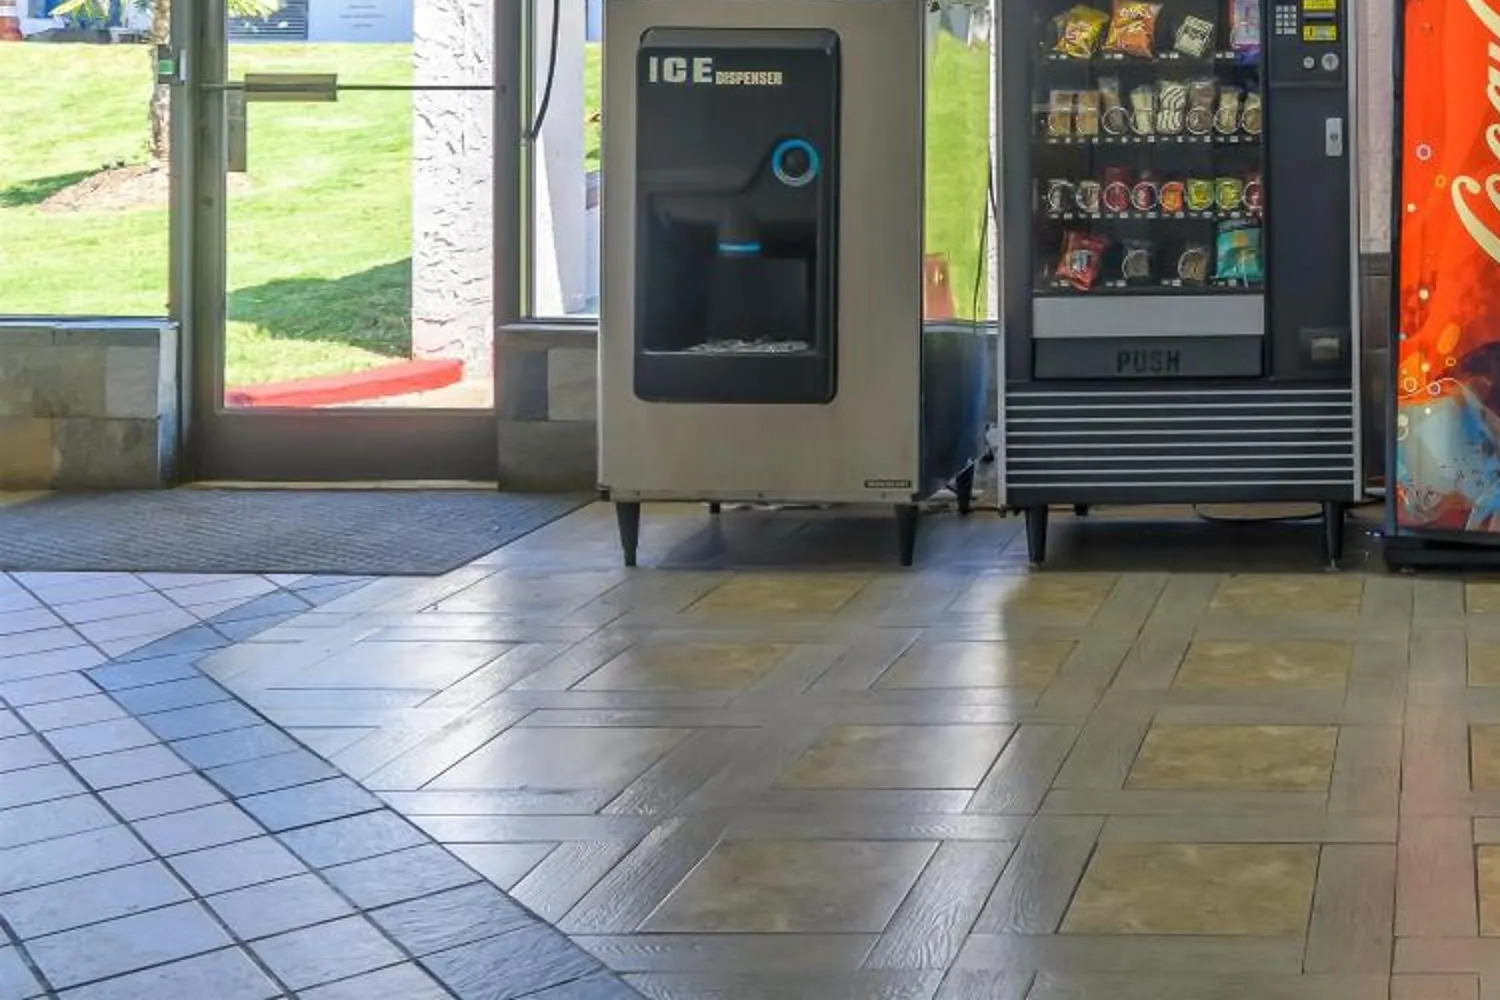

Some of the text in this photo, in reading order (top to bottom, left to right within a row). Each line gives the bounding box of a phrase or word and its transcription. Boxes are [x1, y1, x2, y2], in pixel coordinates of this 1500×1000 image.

[649, 55, 783, 85] ICE DISPENSER
[1117, 349, 1180, 374] PUSH
